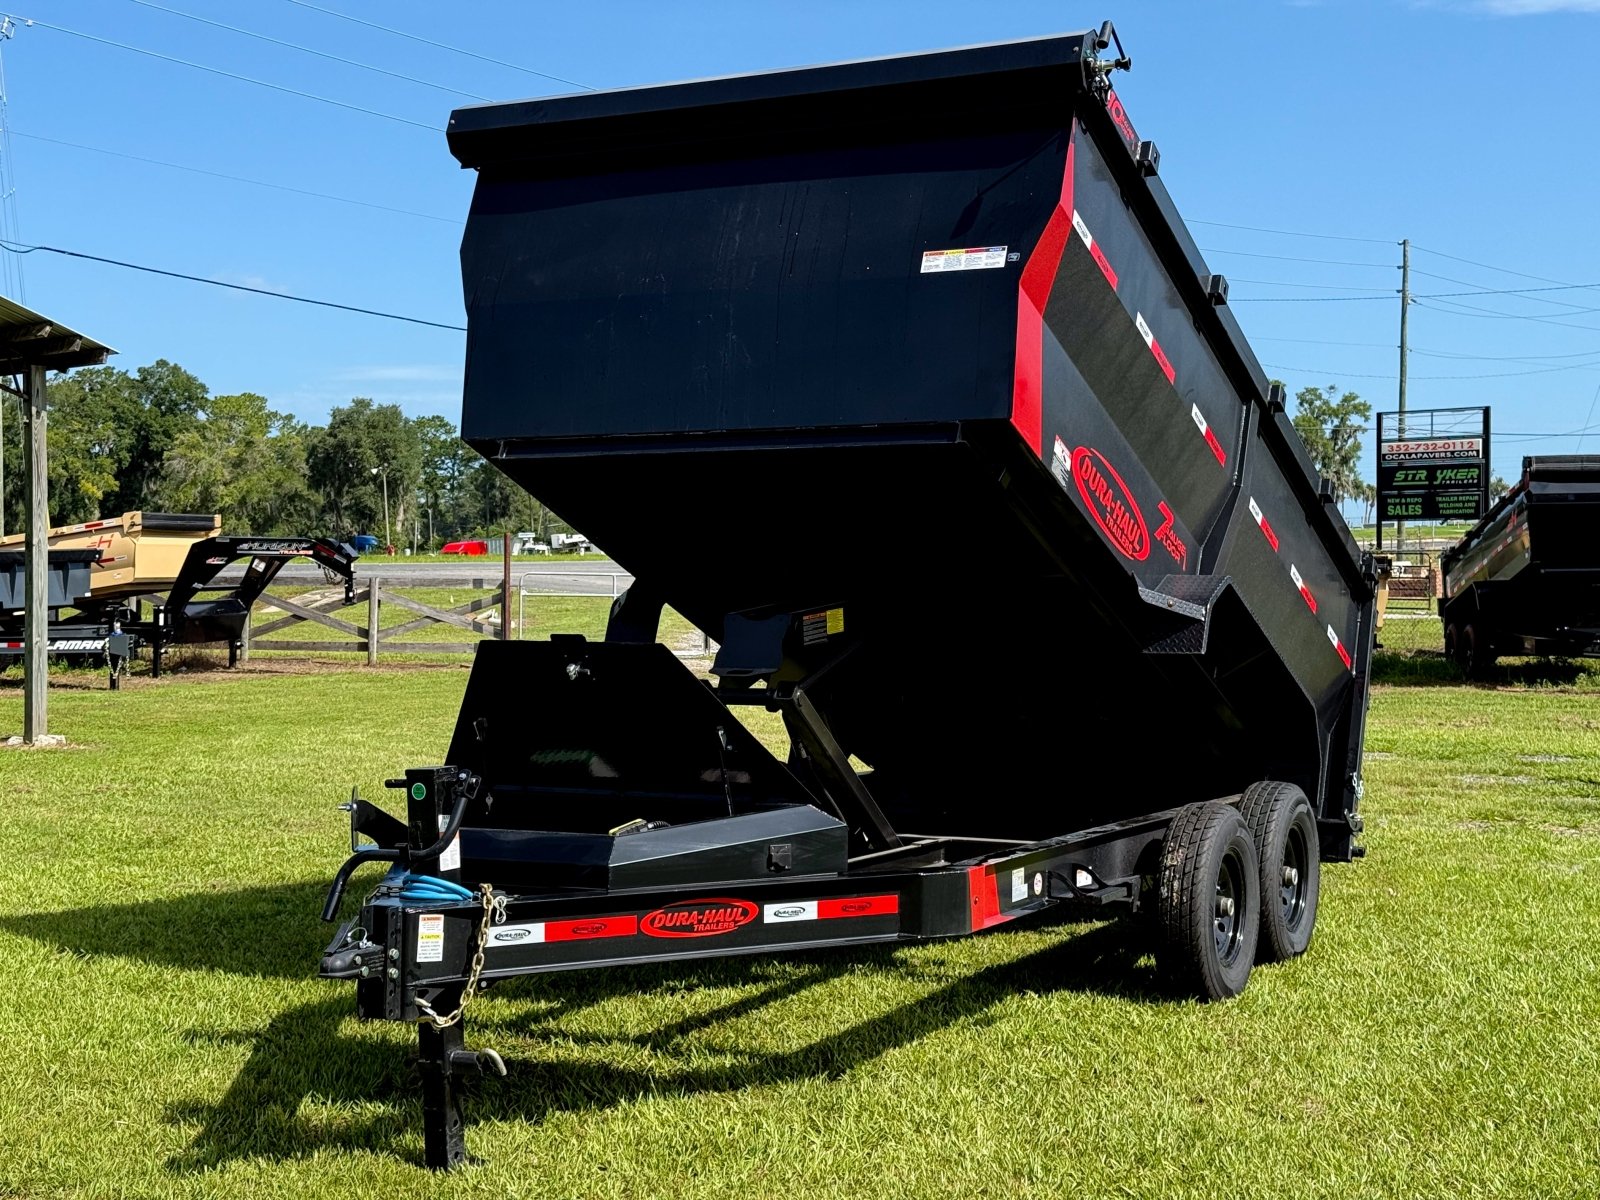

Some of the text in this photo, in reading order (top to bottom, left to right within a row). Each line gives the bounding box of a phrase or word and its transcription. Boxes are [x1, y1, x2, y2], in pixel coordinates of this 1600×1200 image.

[1385, 450, 1477, 460] OCALAPAVERS.COM
[1387, 441, 1474, 453] 352-732-0112
[1080, 456, 1141, 552] DURA-HAUL
[1387, 504, 1423, 516] SALES
[1154, 501, 1174, 541] 7
[1105, 512, 1133, 555] TRAILERS
[1163, 523, 1187, 557] GAUGE
[47, 640, 105, 650] LAMAR
[653, 907, 745, 928] DURA-HAUL
[693, 921, 735, 932] TRAILERS
